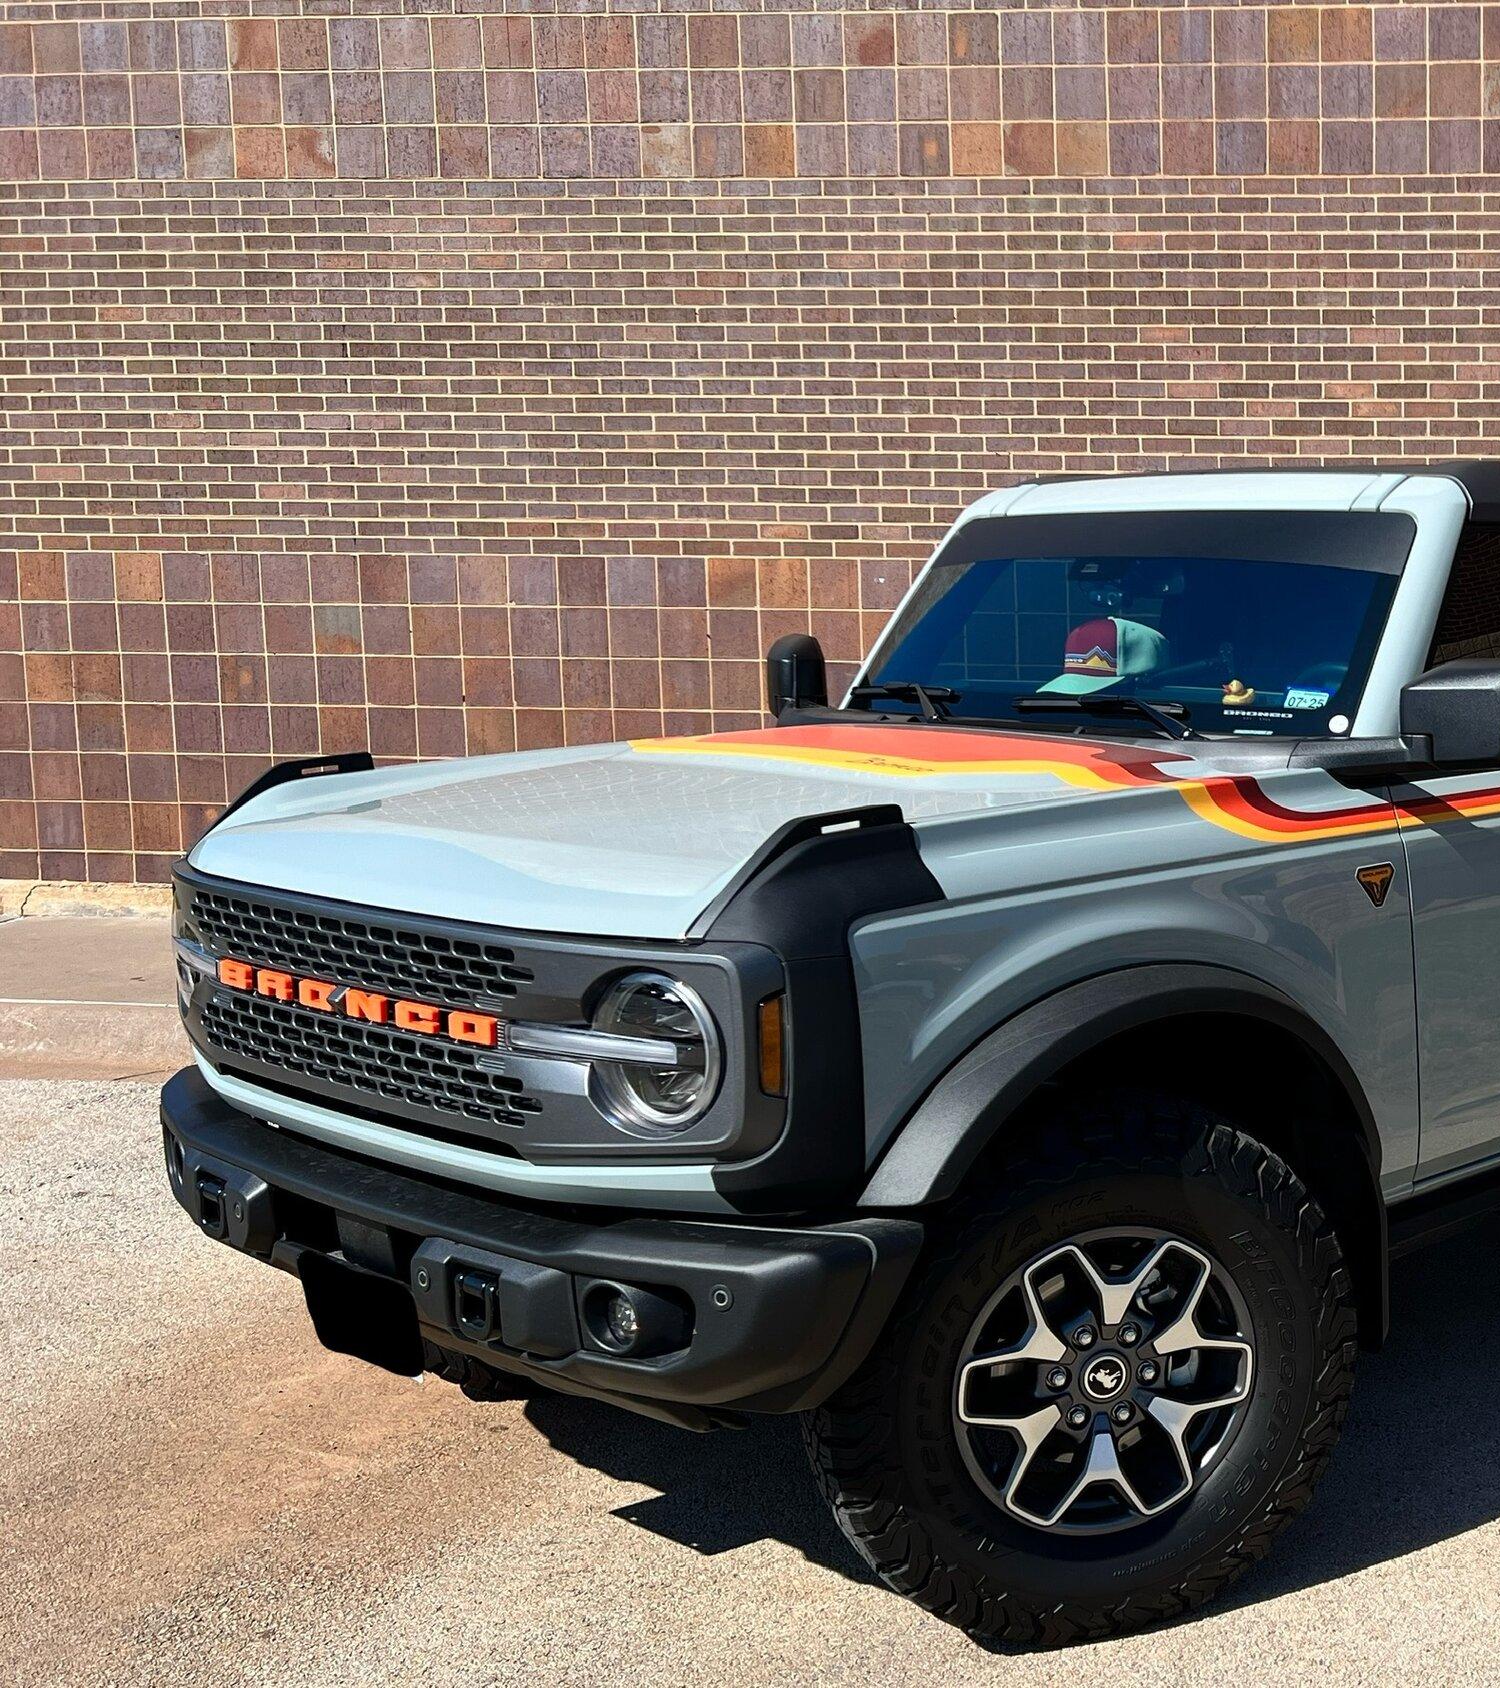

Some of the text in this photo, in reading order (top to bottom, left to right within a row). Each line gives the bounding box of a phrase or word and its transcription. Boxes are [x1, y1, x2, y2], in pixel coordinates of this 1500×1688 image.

[1288, 696, 1325, 709] 07 25
[1223, 709, 1293, 718] BRONCO
[217, 957, 499, 1048] BRONCO
